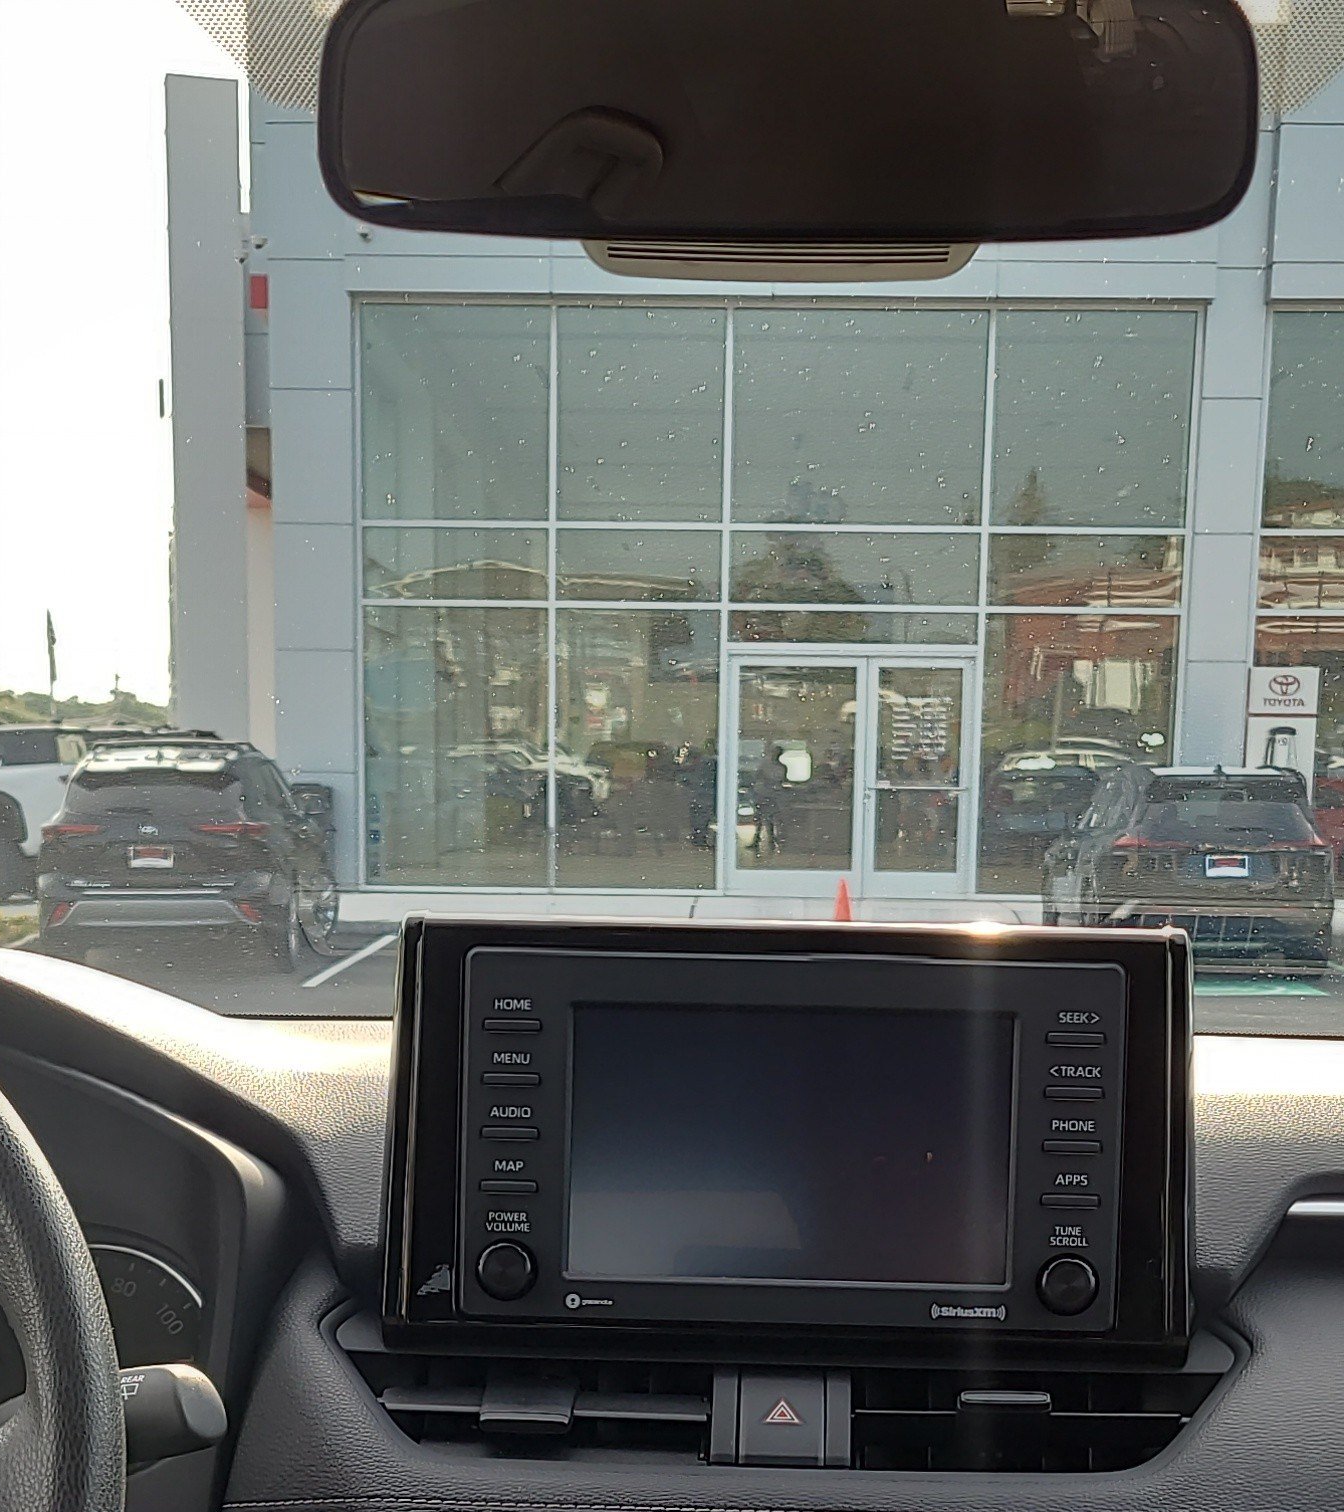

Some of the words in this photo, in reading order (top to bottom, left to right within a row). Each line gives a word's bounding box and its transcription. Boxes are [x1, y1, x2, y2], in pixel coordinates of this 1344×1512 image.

[1263, 697, 1305, 708] TOYOTA
[494, 999, 532, 1010] HOME
[493, 1053, 531, 1064] MENU
[490, 1107, 532, 1118] AUDIO
[1051, 1120, 1096, 1132] PHONE
[494, 1160, 524, 1171] MAP
[1055, 1174, 1089, 1186] APPS
[488, 1212, 528, 1222] POWER
[486, 1222, 531, 1232] VOLUME
[1055, 1226, 1082, 1236] TUNE
[1049, 1236, 1089, 1247] SCROLL
[110, 1276, 137, 1299] 80
[154, 1303, 185, 1337] 100
[120, 1373, 146, 1385] REAR
